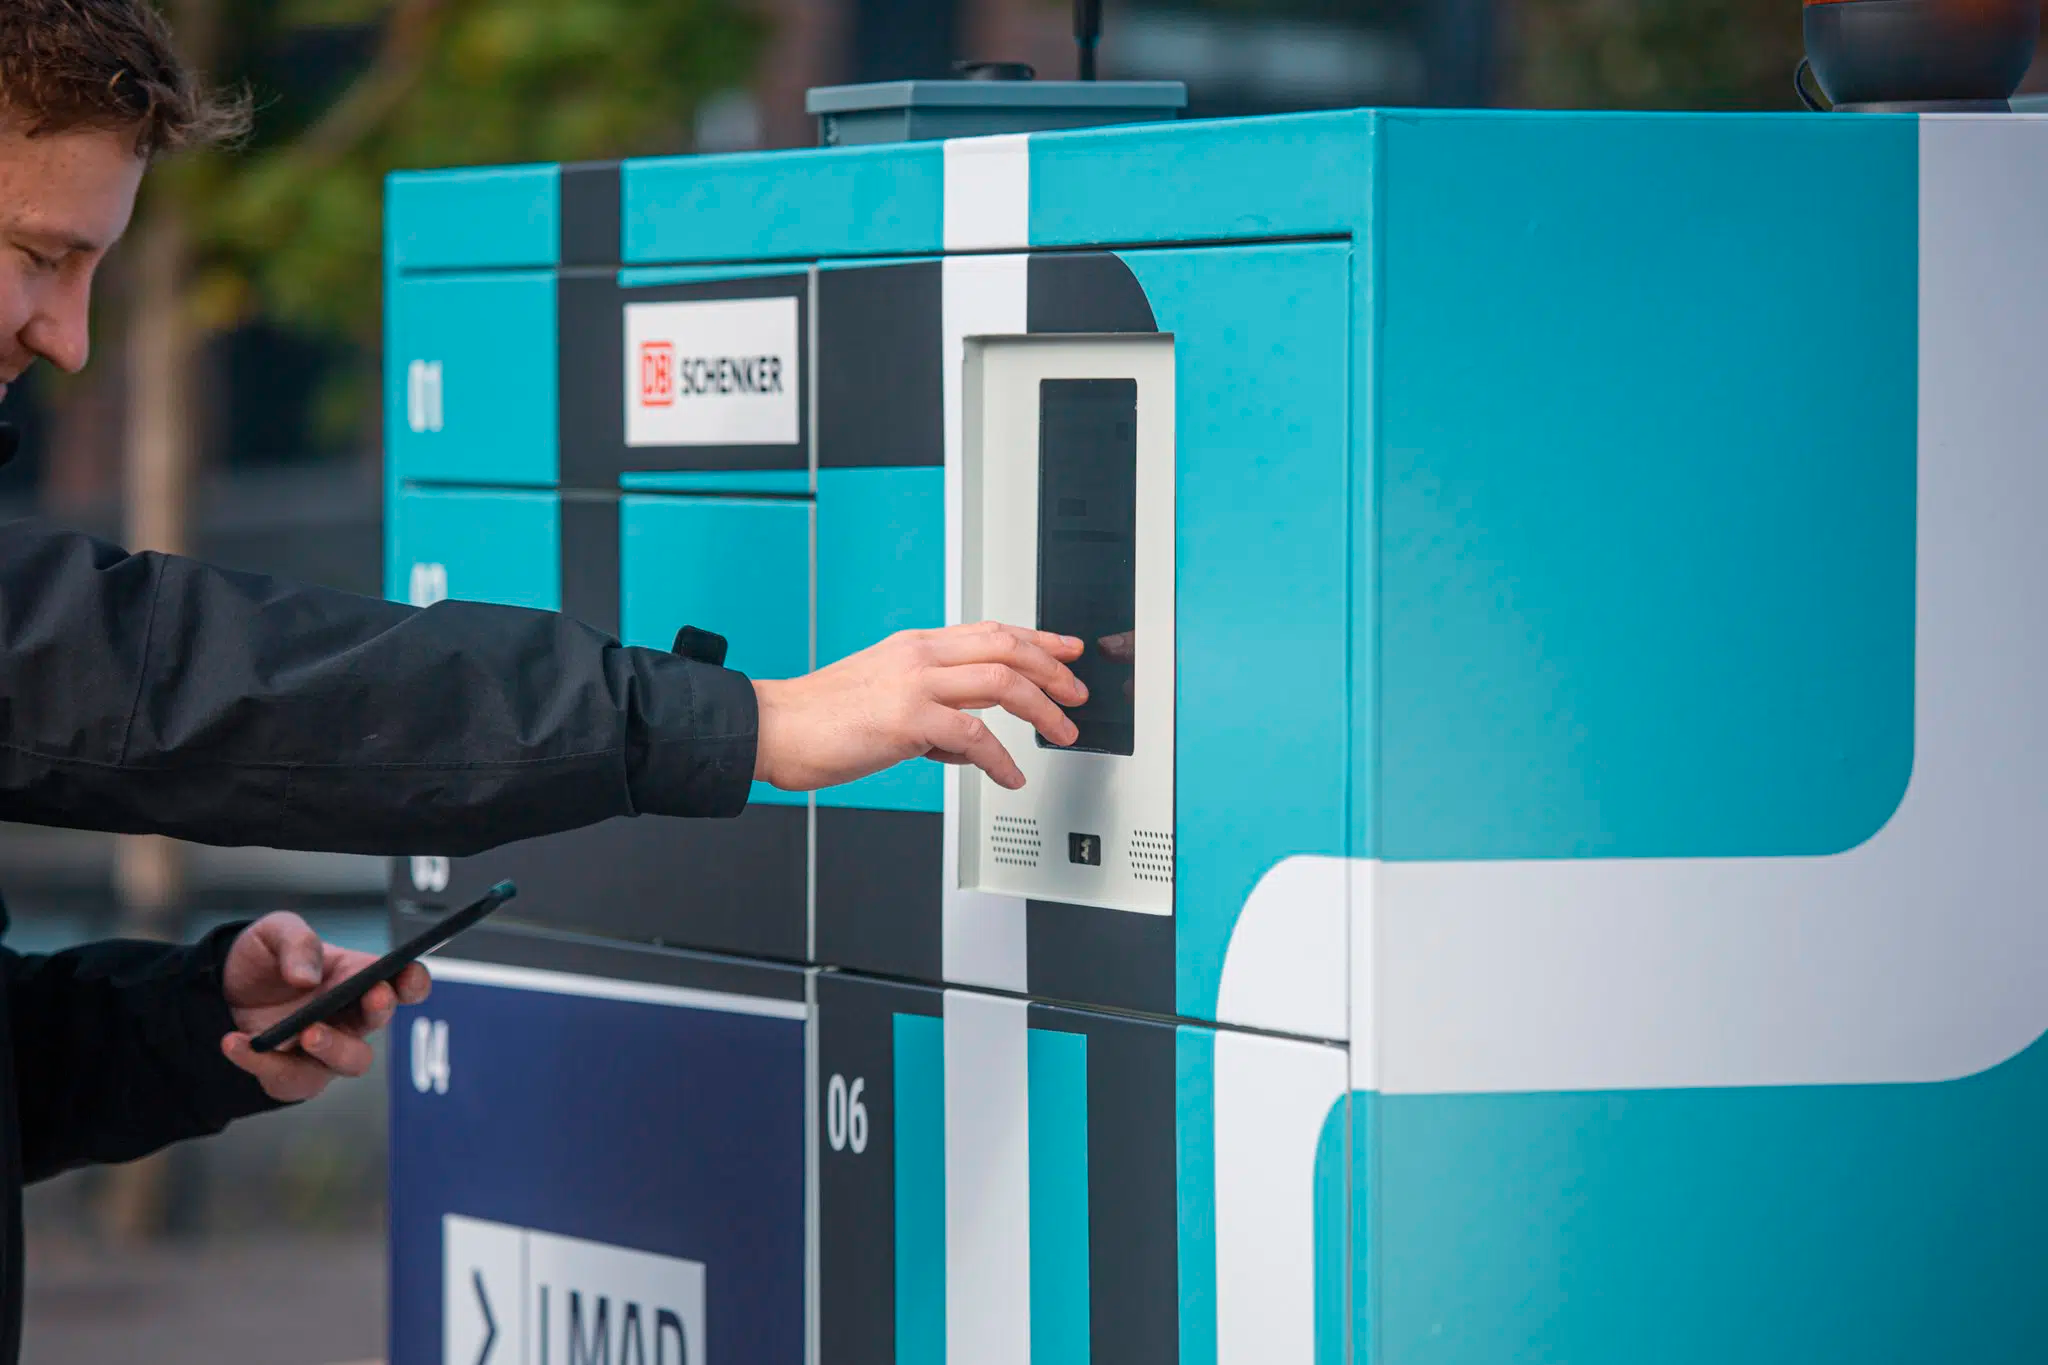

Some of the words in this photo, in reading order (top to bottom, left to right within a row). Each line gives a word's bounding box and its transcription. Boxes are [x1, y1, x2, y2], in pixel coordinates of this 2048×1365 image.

[642, 353, 672, 395] DB
[681, 355, 783, 395] SCHENKER
[411, 1016, 451, 1095] 04
[827, 1073, 868, 1154] 06
